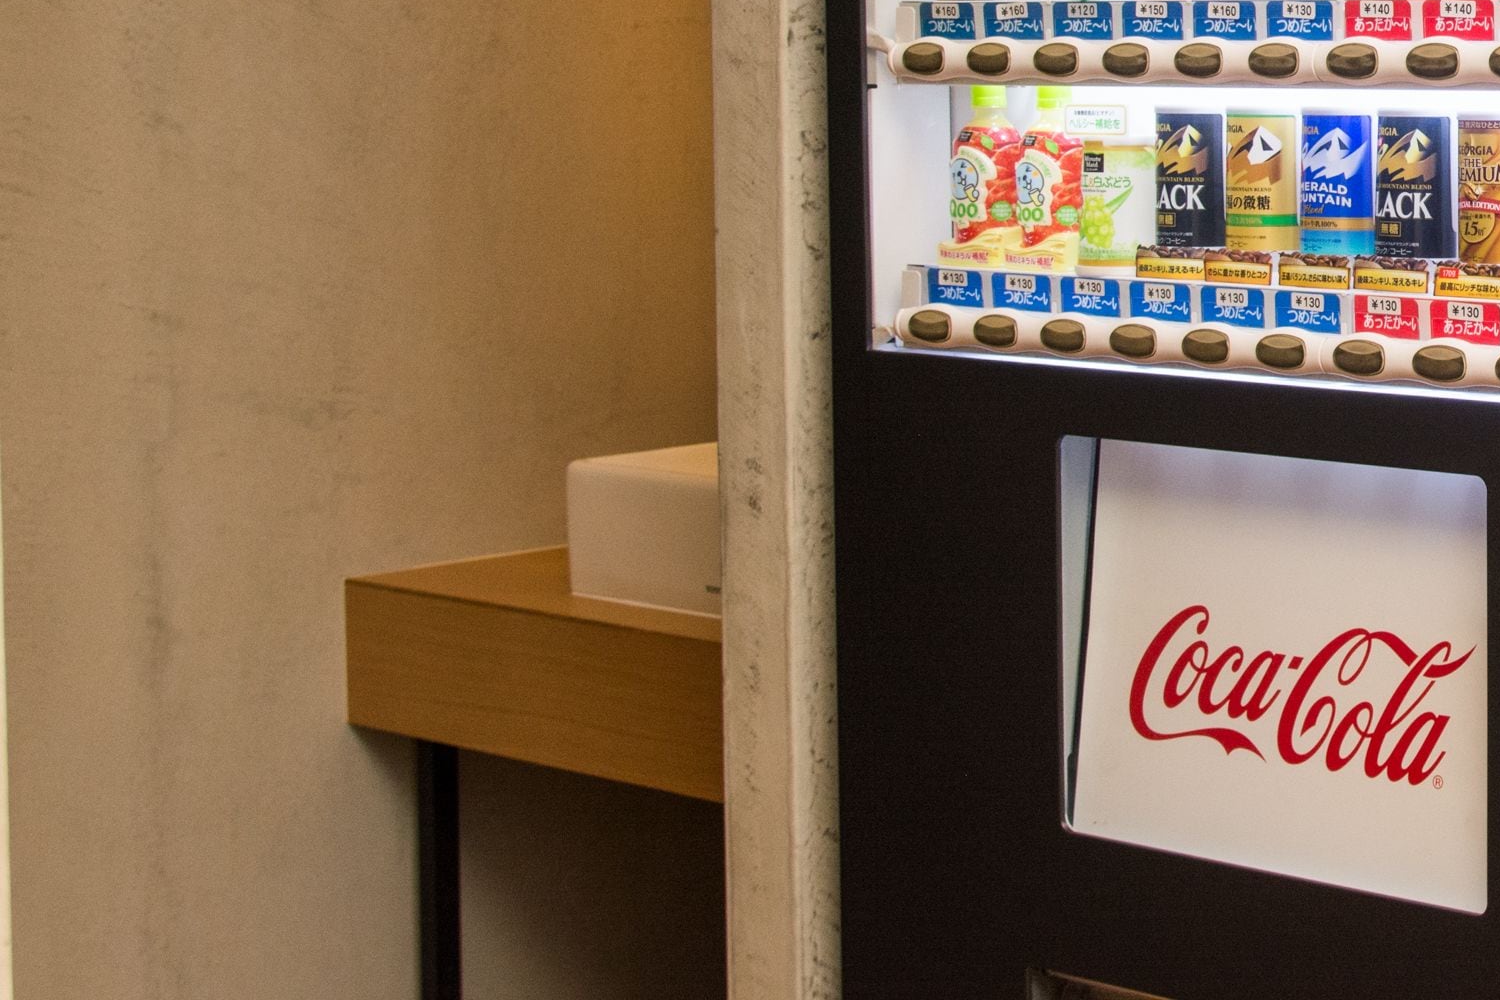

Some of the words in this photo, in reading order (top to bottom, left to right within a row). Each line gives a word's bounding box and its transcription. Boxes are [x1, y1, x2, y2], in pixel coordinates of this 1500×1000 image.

[935, 6, 956, 16] ¥160
[1001, 5, 1025, 16] ¥160
[1071, 5, 1095, 16] ¥120
[1140, 5, 1164, 15] ¥150
[1212, 5, 1237, 16] ¥160
[1287, 4, 1312, 16] ¥130
[1364, 3, 1390, 14] ¥140
[1445, 3, 1472, 14] ¥140
[1463, 158, 1482, 168] THE
[942, 272, 965, 284] ¥130
[1010, 277, 1033, 290] ¥130
[1079, 281, 1102, 293] ¥130
[1148, 288, 1172, 299] ¥130
[1219, 292, 1244, 304] ¥130
[1295, 297, 1321, 308] ¥130
[1371, 300, 1397, 312] ¥130
[1451, 305, 1480, 318] ¥130
[1129, 604, 1478, 787] Coca-Cola
